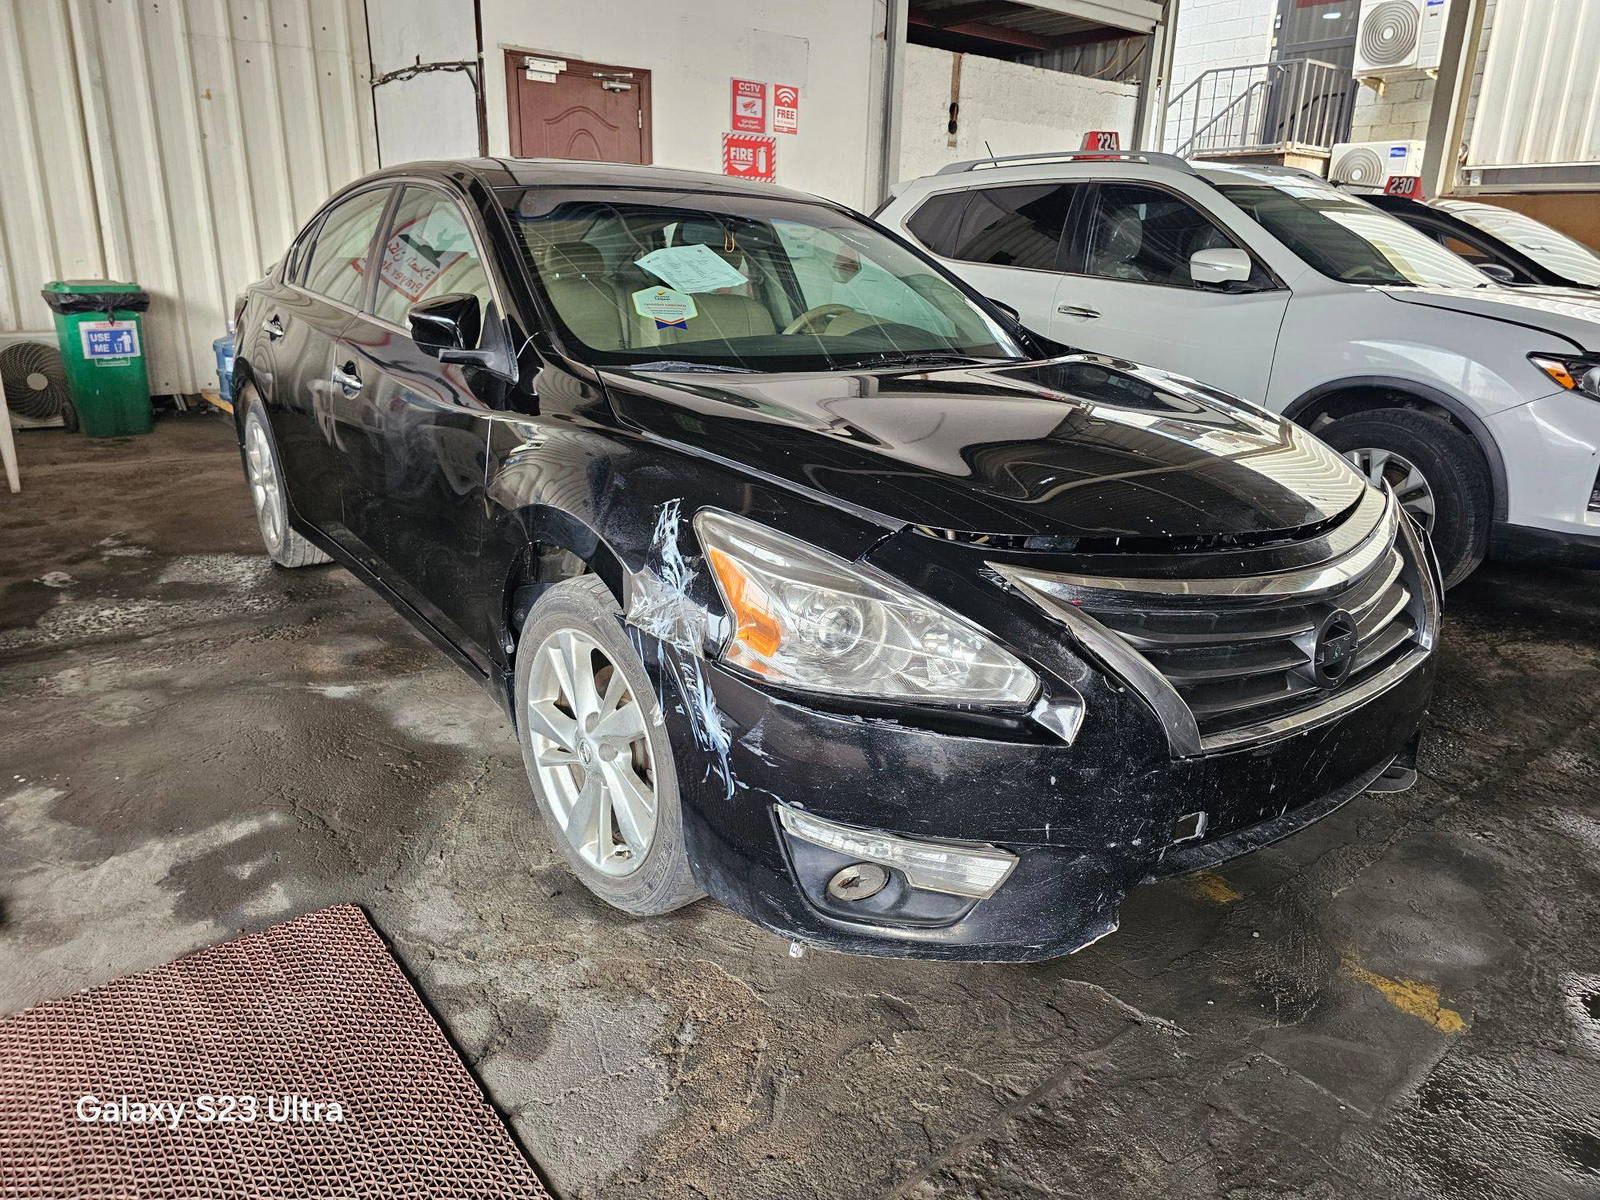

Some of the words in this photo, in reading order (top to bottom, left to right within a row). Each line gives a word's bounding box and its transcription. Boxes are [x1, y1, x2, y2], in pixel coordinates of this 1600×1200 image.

[738, 82, 761, 92] CCTV
[777, 108, 795, 120] FREE
[1097, 133, 1117, 151] 224
[730, 147, 754, 161] FIRE
[1389, 177, 1415, 193] 230
[89, 333, 111, 342] USE
[94, 343, 110, 353] ME
